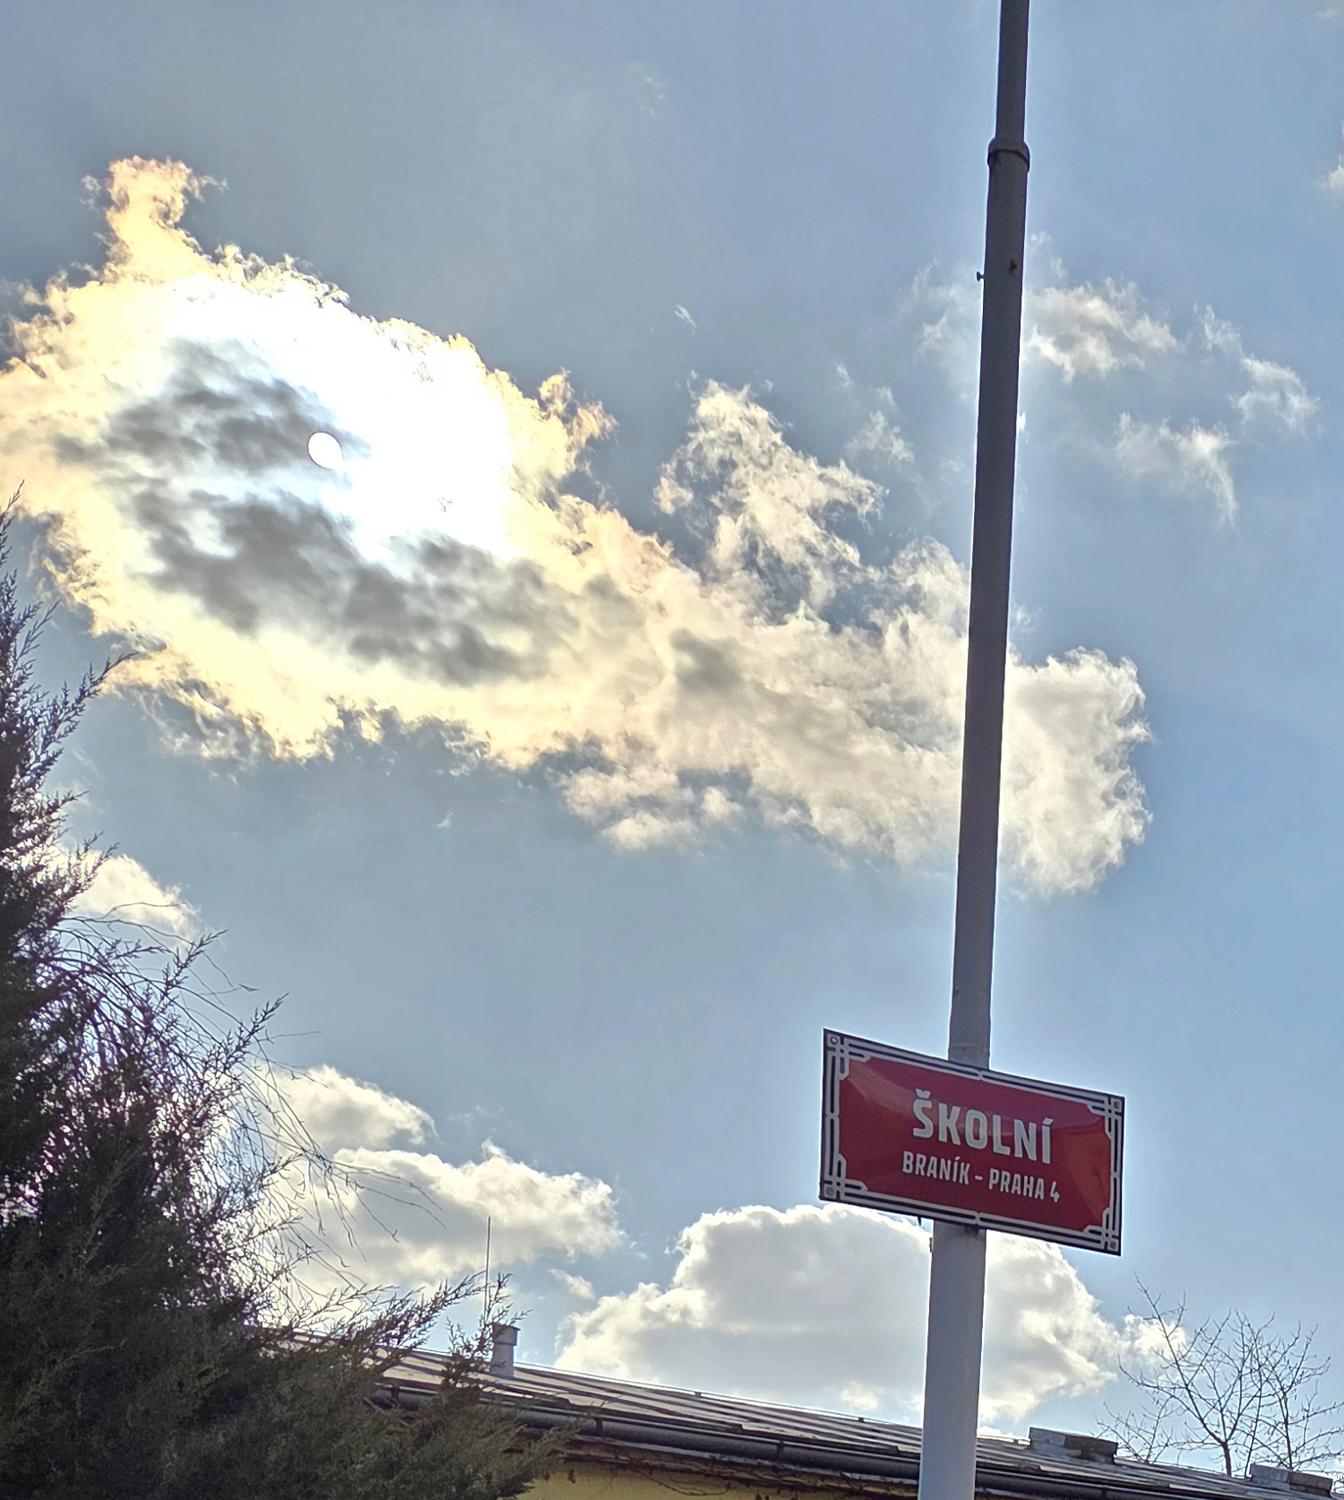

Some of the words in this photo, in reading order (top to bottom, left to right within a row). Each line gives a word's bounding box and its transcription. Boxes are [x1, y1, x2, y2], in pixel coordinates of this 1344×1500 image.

[912, 1088, 1054, 1164] ŠKOLNÍ
[902, 1150, 970, 1185] BRANÍK
[988, 1167, 1045, 1200] PRAHA
[1049, 1180, 1060, 1202] 4
